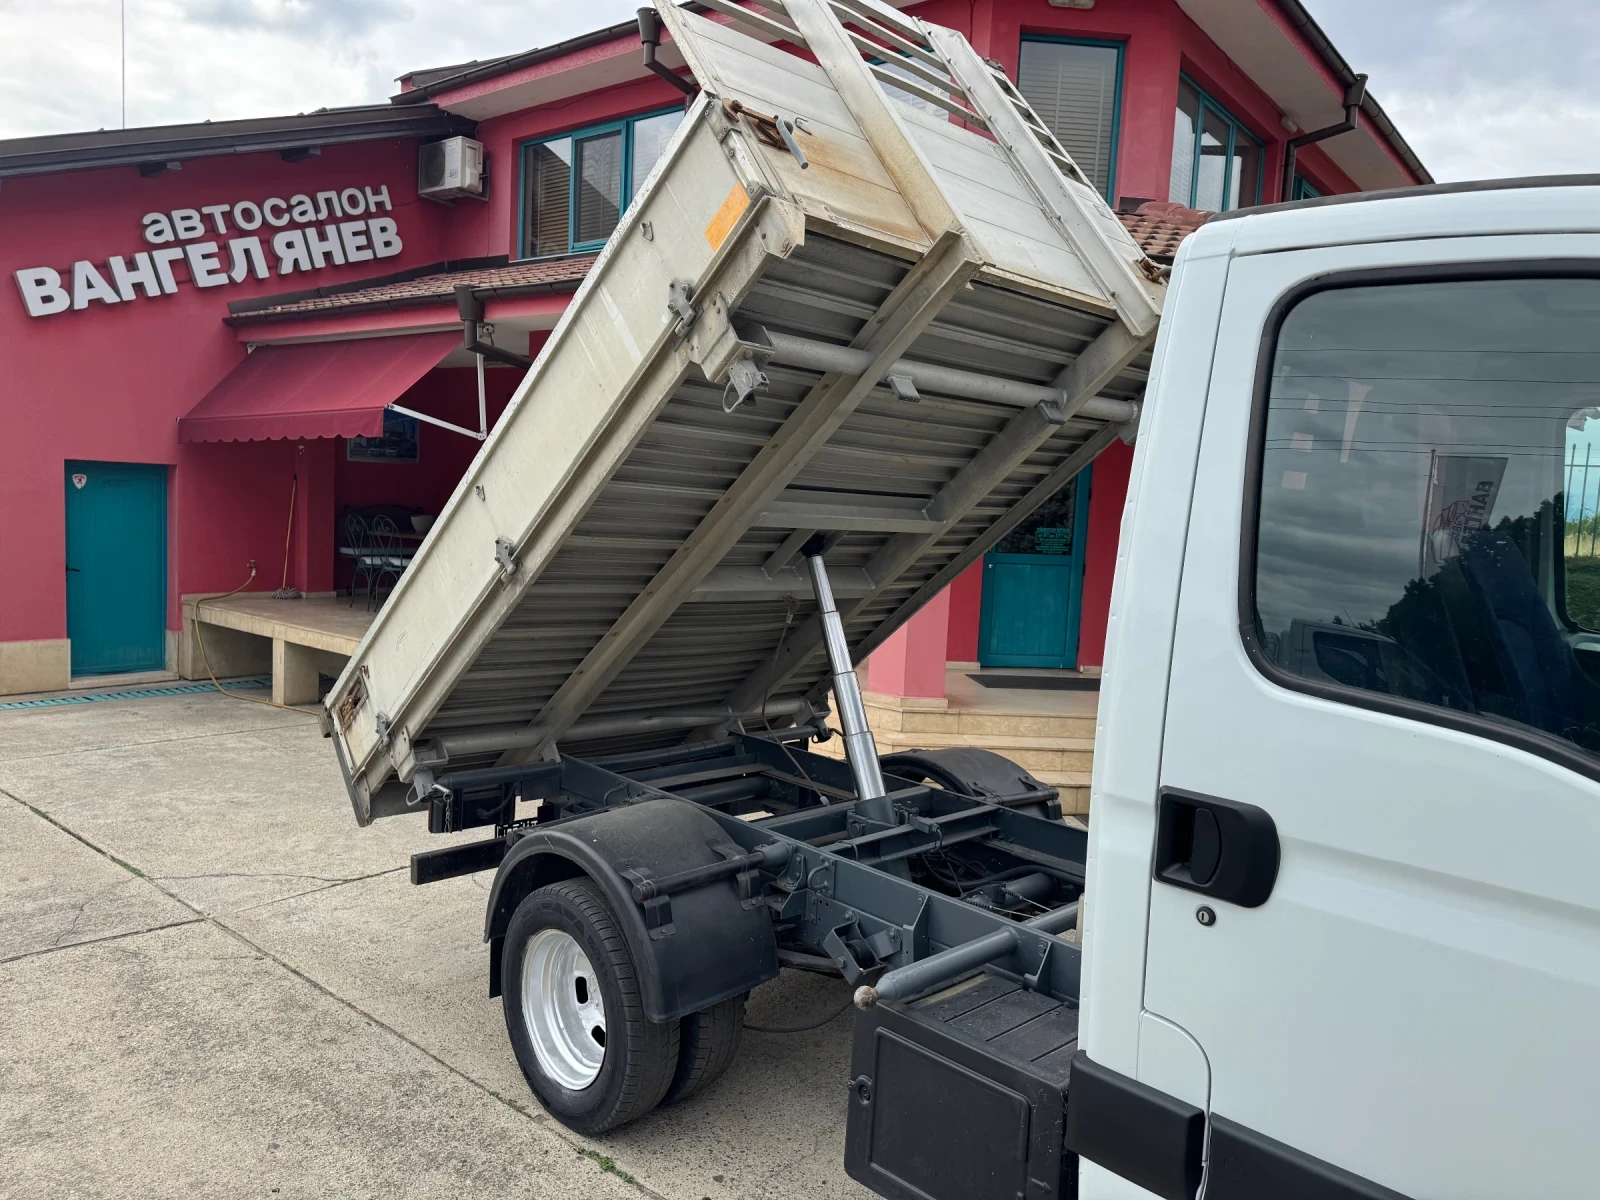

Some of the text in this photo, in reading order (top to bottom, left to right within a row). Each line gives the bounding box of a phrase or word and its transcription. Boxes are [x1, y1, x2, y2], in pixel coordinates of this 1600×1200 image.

[141, 185, 393, 244] автосалон
[13, 217, 403, 317] ВАНГЕЛ ЯНЕВ
